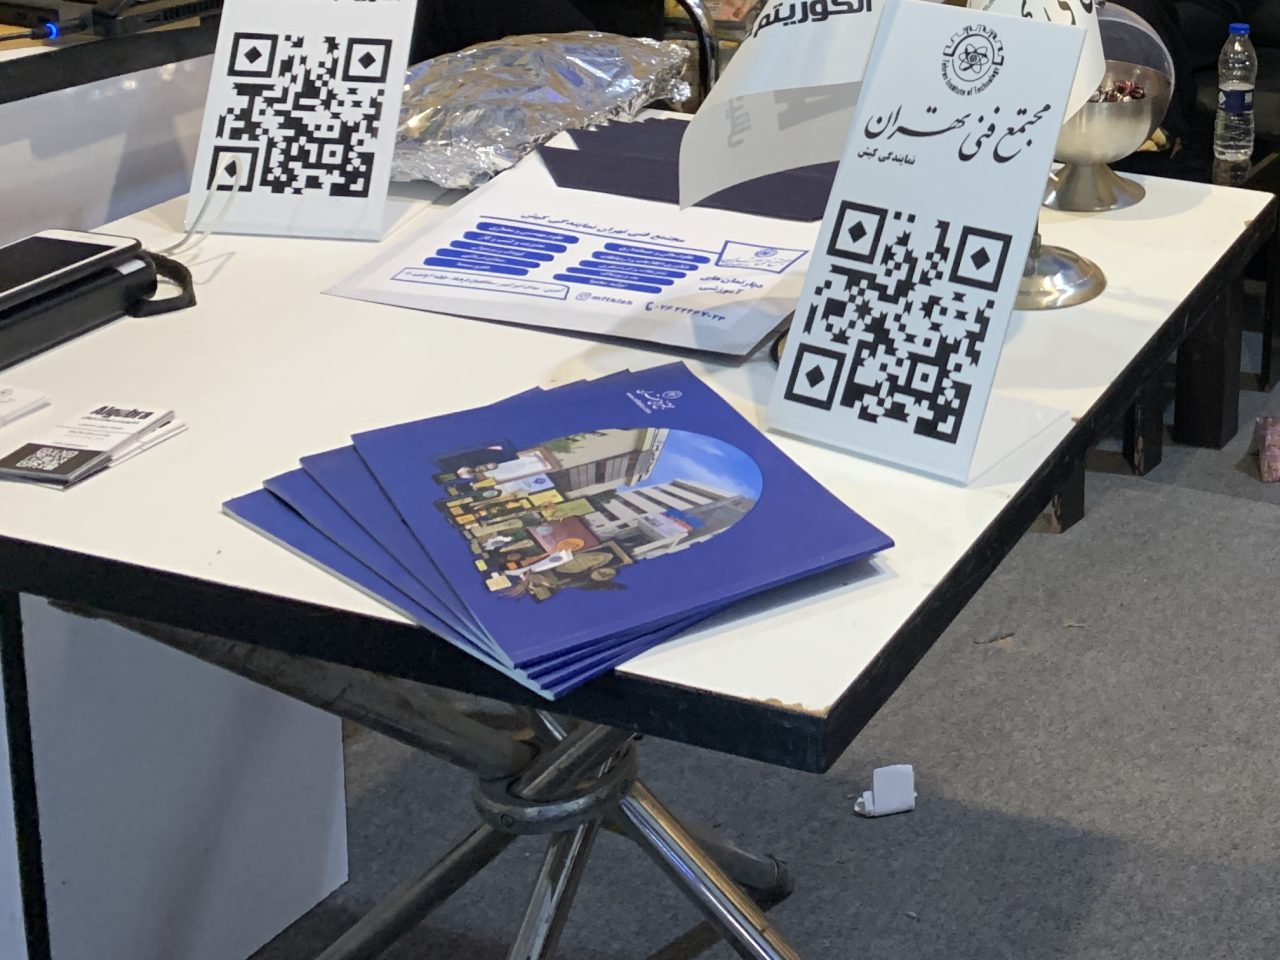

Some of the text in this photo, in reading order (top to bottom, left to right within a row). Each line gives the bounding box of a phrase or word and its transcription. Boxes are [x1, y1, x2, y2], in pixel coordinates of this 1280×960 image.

[864, 104, 972, 140] تهران
[958, 106, 1001, 162] فنی
[993, 103, 1051, 163] مجتمع
[857, 147, 916, 165] نمایندگی کیش
